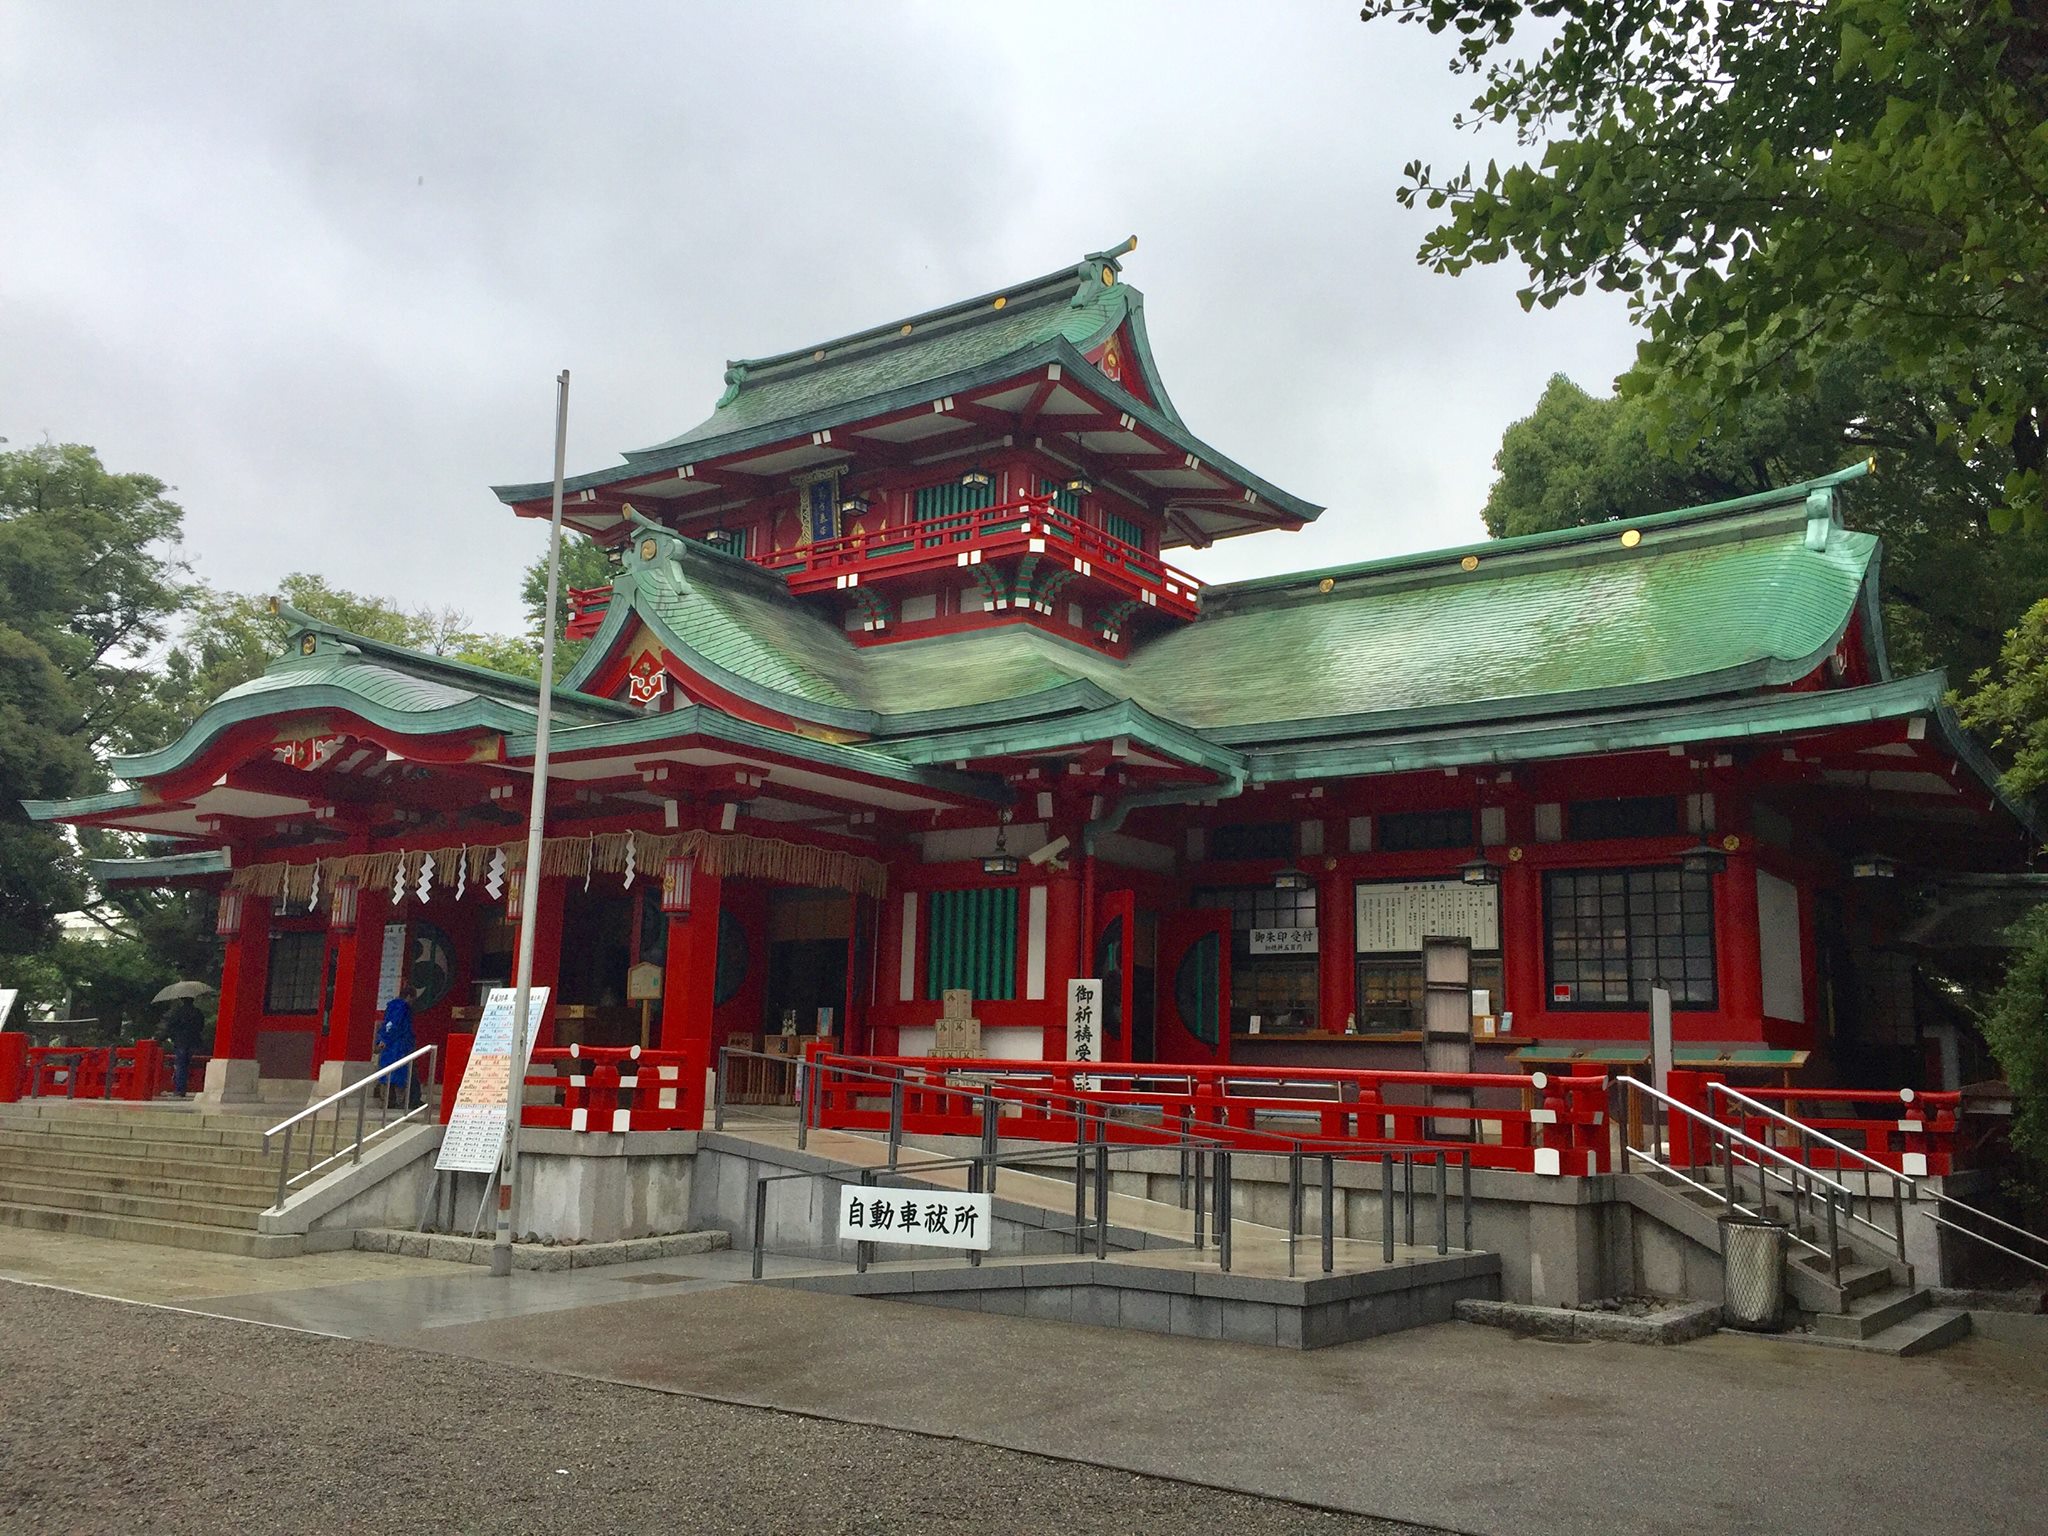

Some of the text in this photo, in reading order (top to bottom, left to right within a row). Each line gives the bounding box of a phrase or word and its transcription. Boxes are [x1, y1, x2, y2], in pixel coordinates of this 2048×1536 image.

[848, 1196, 979, 1239] 自動車祓所
